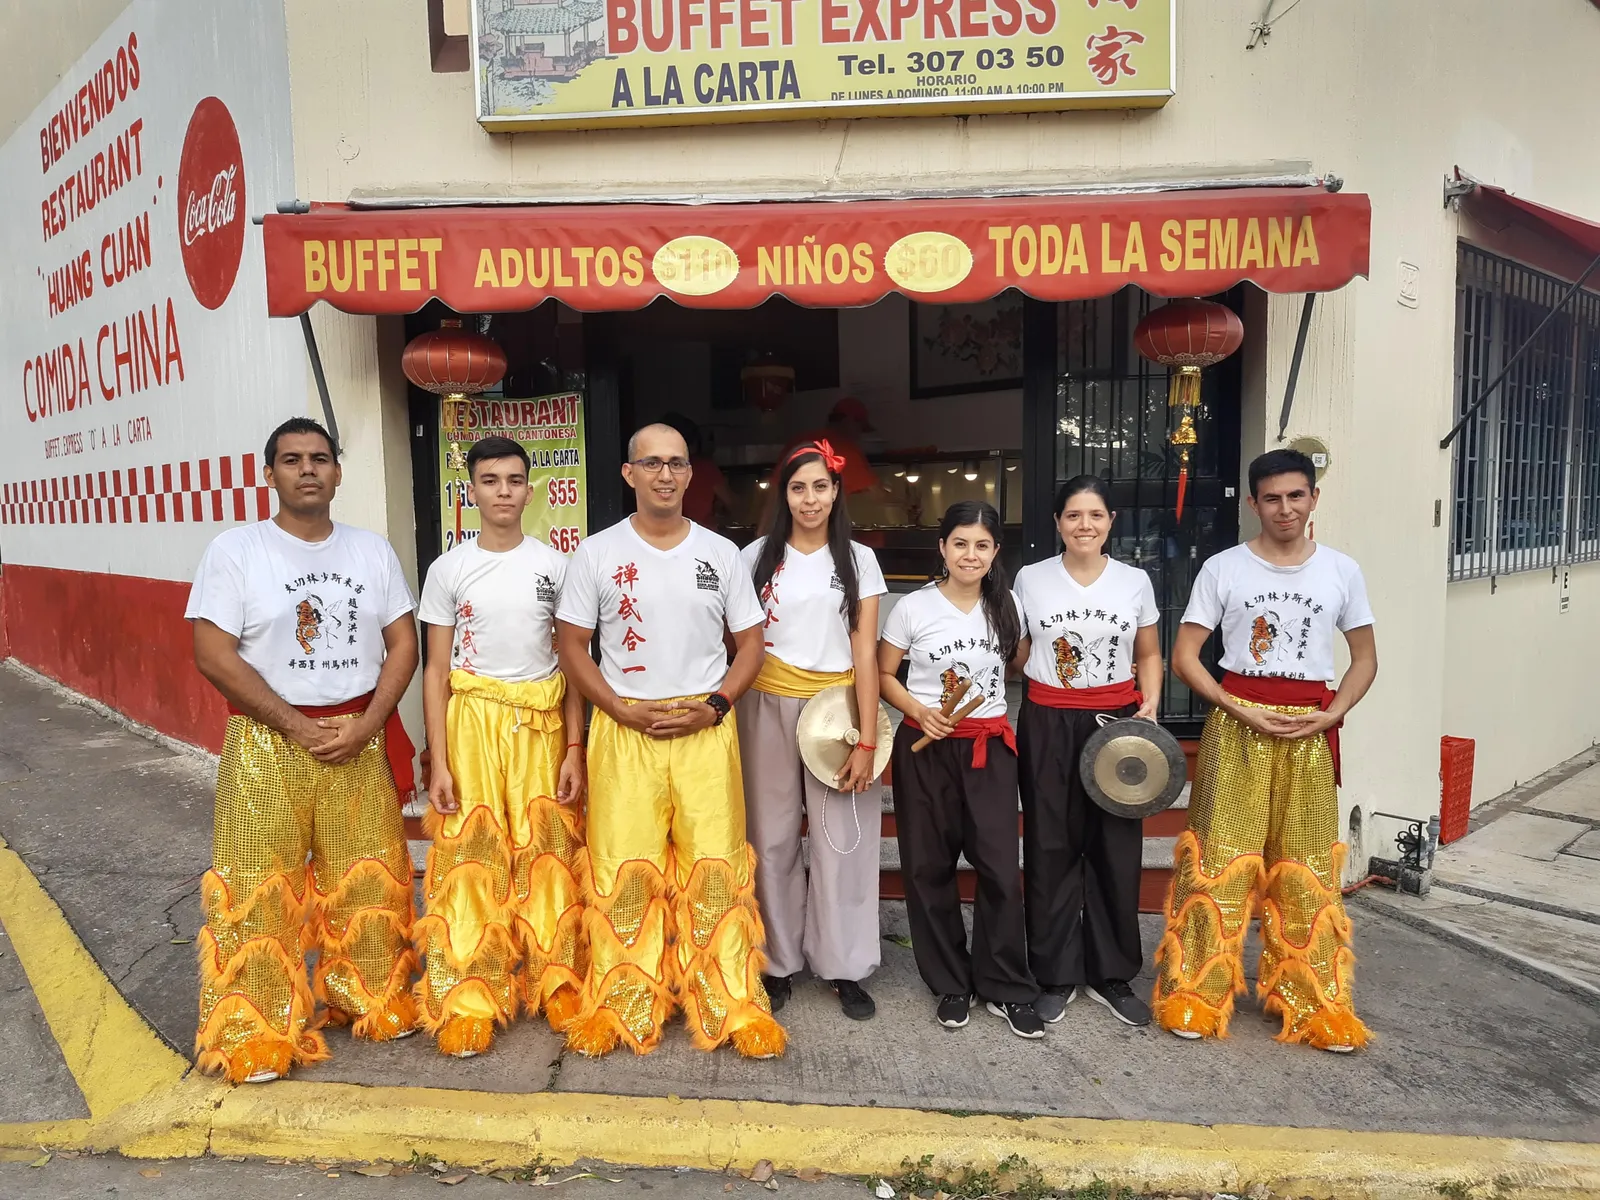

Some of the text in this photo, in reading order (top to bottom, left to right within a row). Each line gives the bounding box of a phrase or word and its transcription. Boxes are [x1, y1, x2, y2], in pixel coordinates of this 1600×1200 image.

[608, 0, 1057, 54] BUFFET EXPRESS
[838, 45, 1065, 76] Tel. 307 03 50
[612, 60, 801, 108] A LA CARTA
[831, 82, 1064, 101] DE LUNES A DOMINGO 11:00 AM A 10:00 PM
[917, 73, 977, 87] HORARIO
[40, 31, 140, 175] BIENVENIDOS
[41, 118, 143, 242] RESTAURANT
[303, 237, 442, 293] BUFFET
[474, 245, 645, 288] ADULTOS
[756, 236, 874, 286] NIÑOS
[988, 223, 1089, 277] TODA
[1101, 221, 1148, 273] LA
[1160, 215, 1320, 272] SEMANA
[24, 297, 185, 423] COMIDA CHINA
[102, 426, 107, 448] A
[113, 423, 121, 446] LA
[127, 415, 152, 444] CARTA
[519, 427, 577, 441] CANTONESA
[532, 449, 580, 467] A LA CARTA
[445, 481, 452, 507] 1
[548, 477, 578, 508] $55
[549, 527, 580, 554] $65
